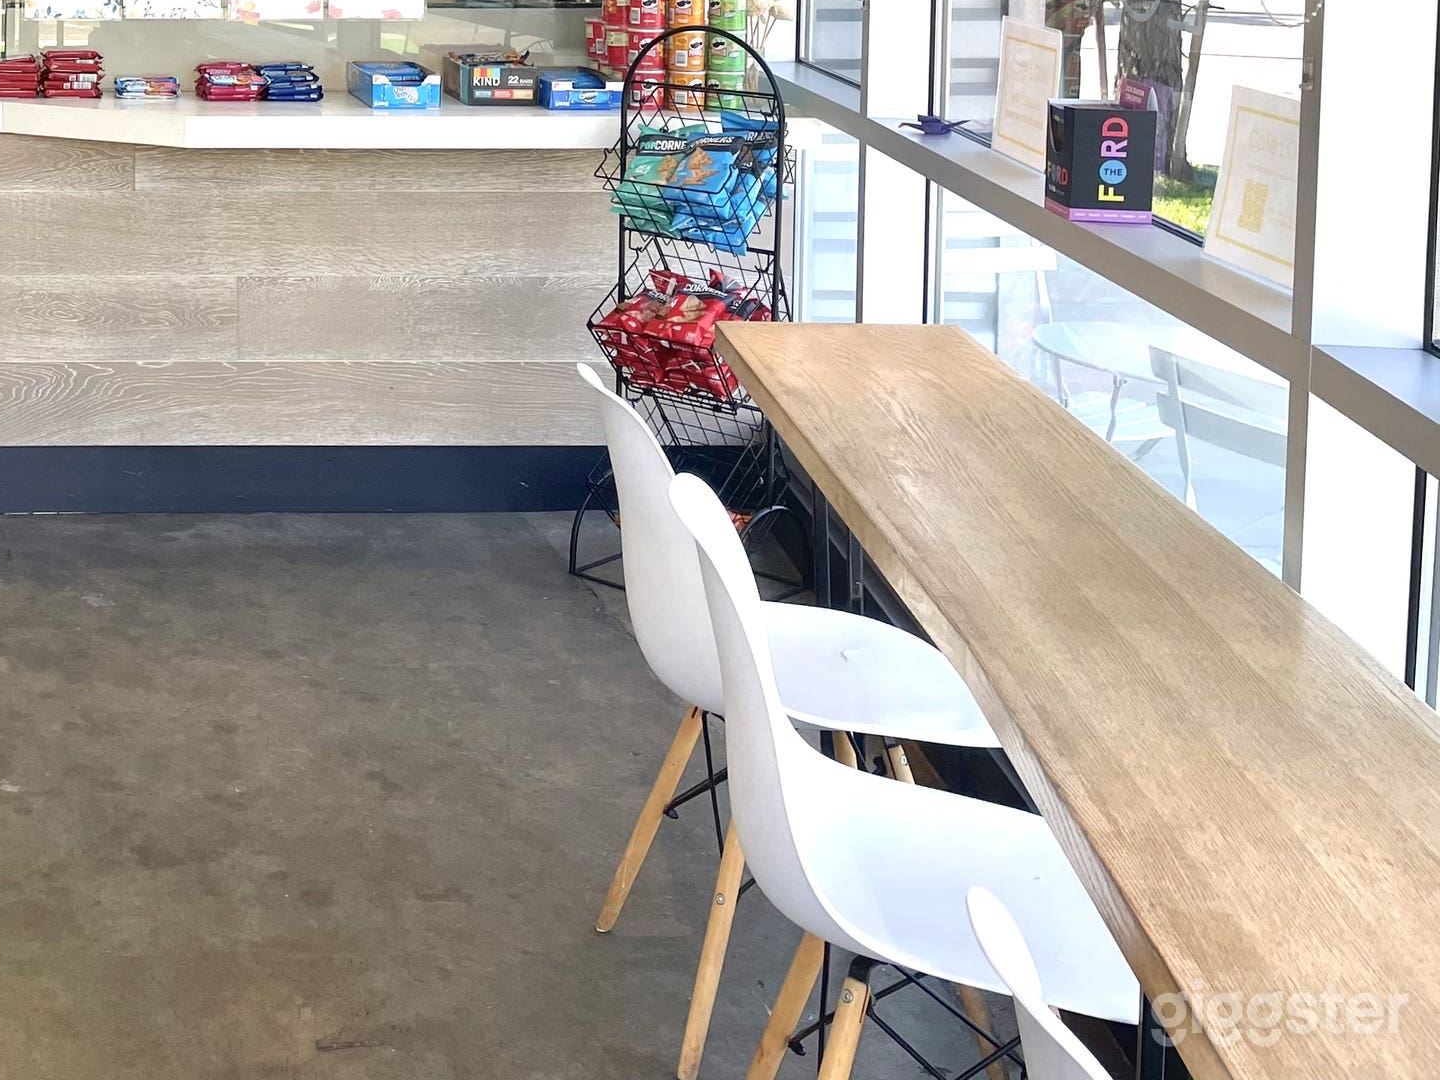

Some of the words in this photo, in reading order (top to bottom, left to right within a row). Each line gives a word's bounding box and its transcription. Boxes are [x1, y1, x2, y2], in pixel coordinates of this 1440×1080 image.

[473, 77, 501, 87] KIND
[507, 76, 520, 84] 22
[1103, 168, 1123, 177] THE
